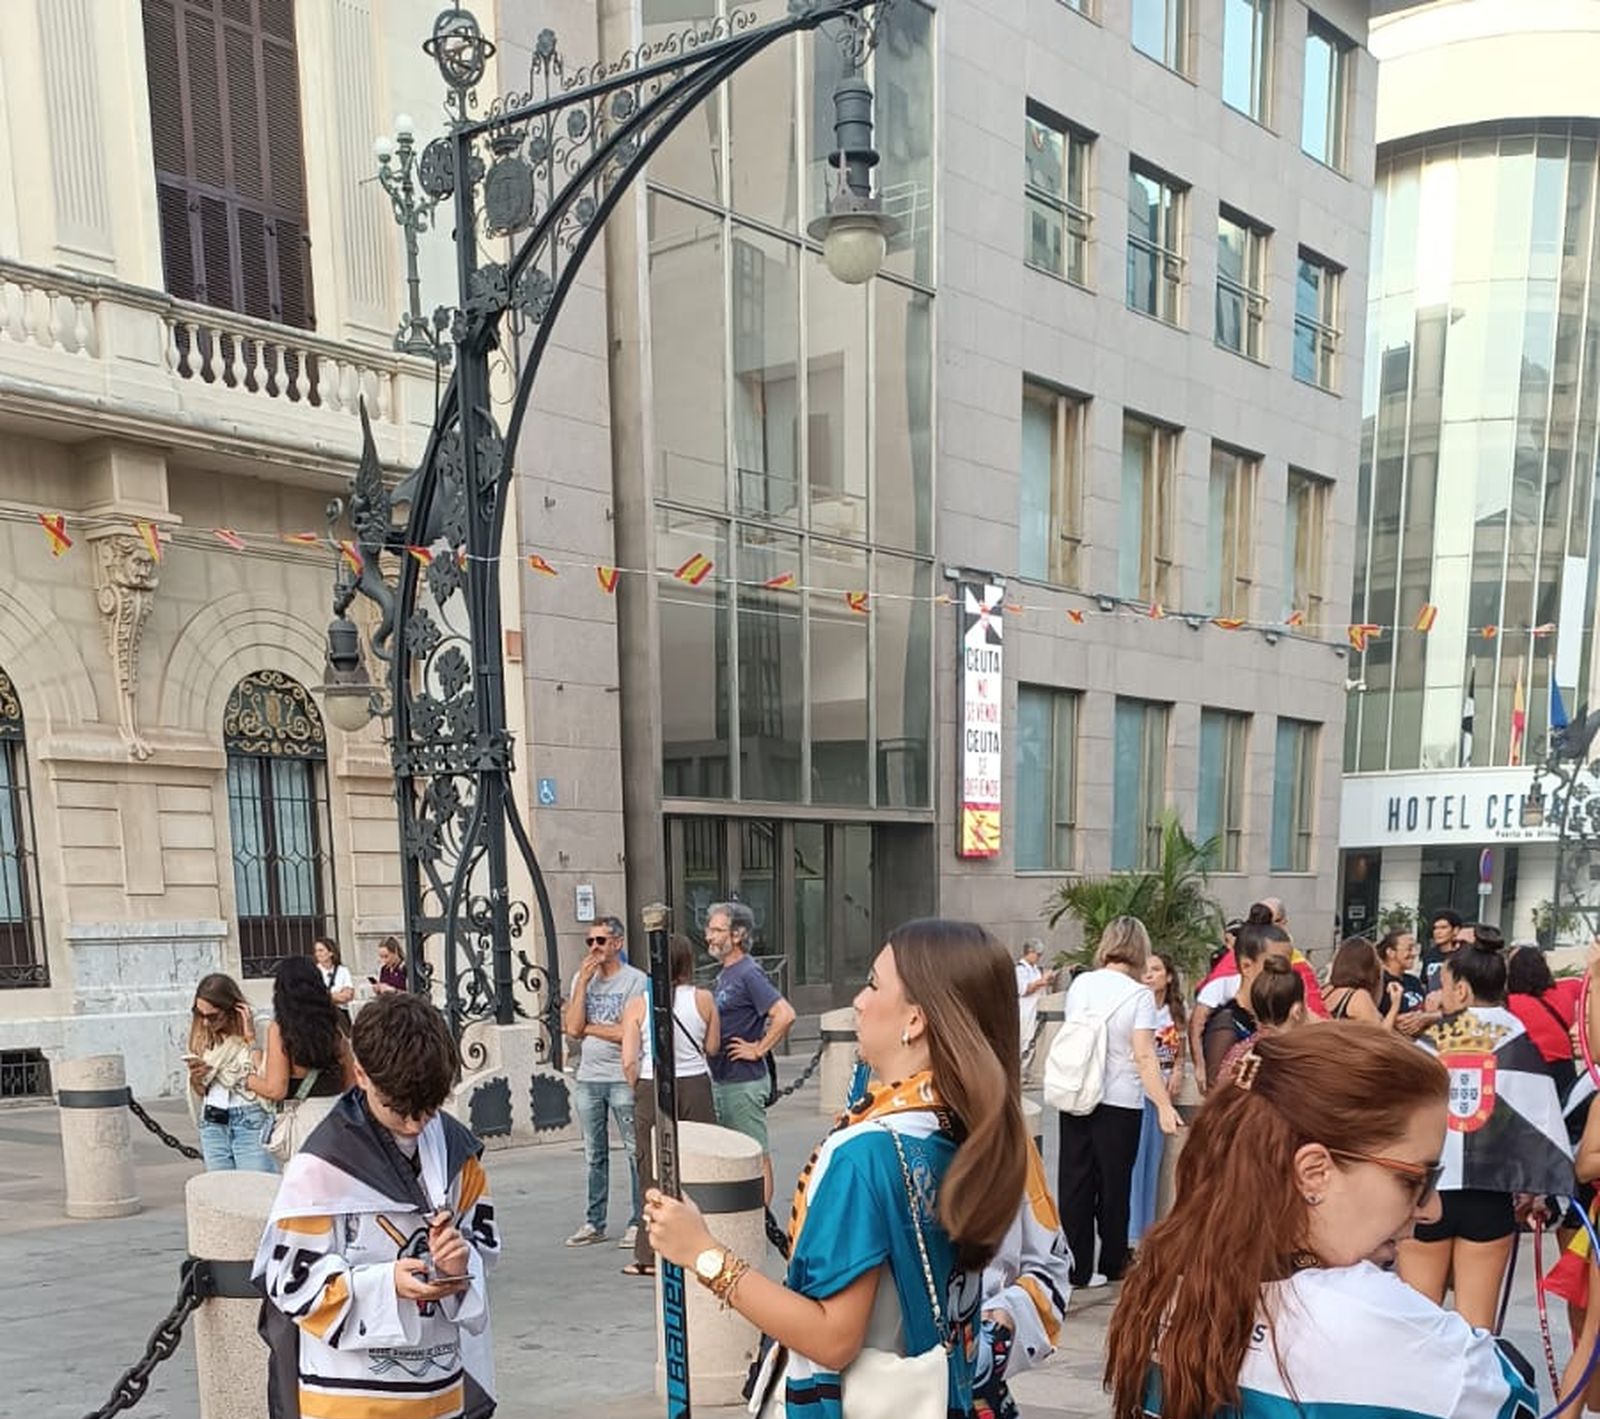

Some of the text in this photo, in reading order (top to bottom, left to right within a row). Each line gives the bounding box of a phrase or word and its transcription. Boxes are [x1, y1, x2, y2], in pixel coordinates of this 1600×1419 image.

[966, 647, 1000, 674] CEUTA
[966, 728, 1000, 754] CEUTA
[1388, 795, 1470, 832] HOTEL
